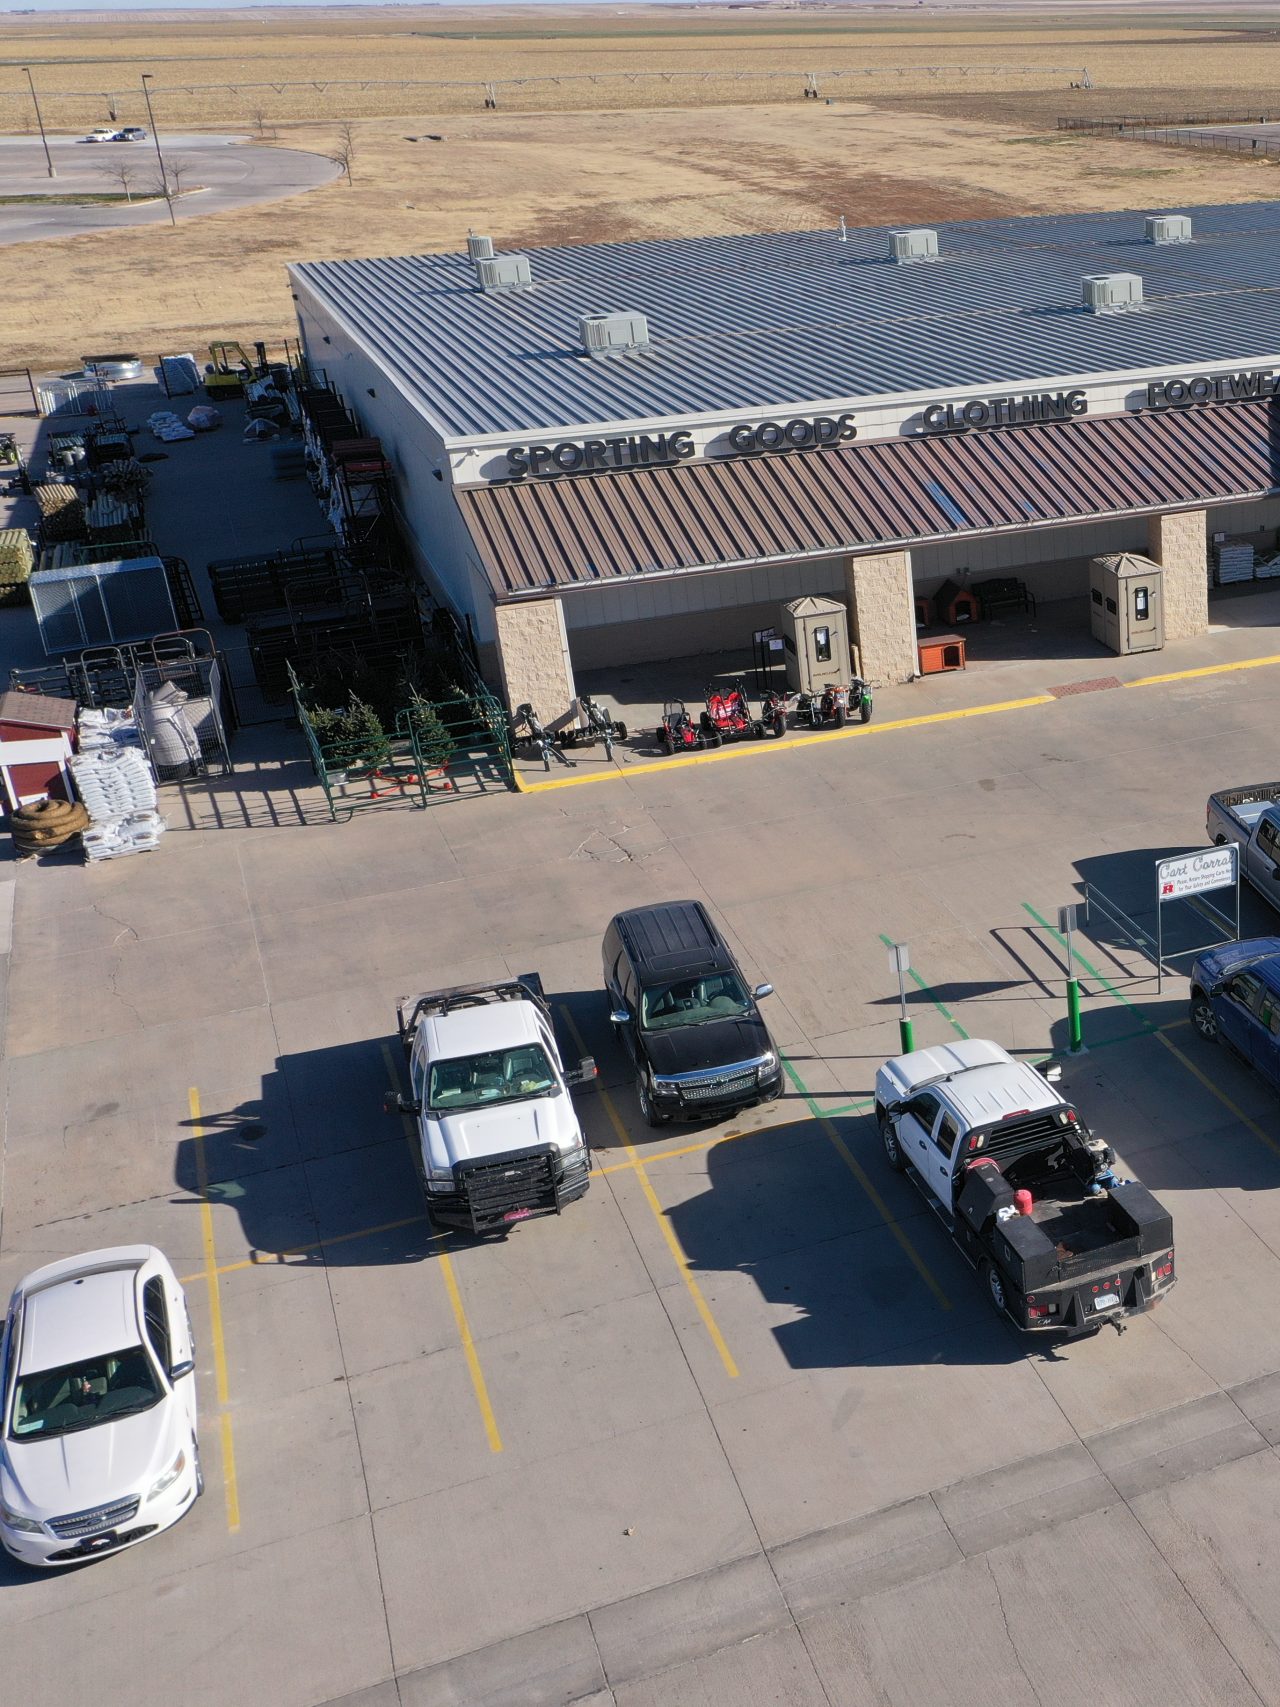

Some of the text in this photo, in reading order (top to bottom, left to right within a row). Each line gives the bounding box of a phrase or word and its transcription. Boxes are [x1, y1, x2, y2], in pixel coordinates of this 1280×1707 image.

[505, 430, 696, 477] SPORTING
[729, 413, 858, 453] GOODS
[922, 389, 1088, 431] CLOTHING
[1160, 849, 1235, 880] Cart Corral
